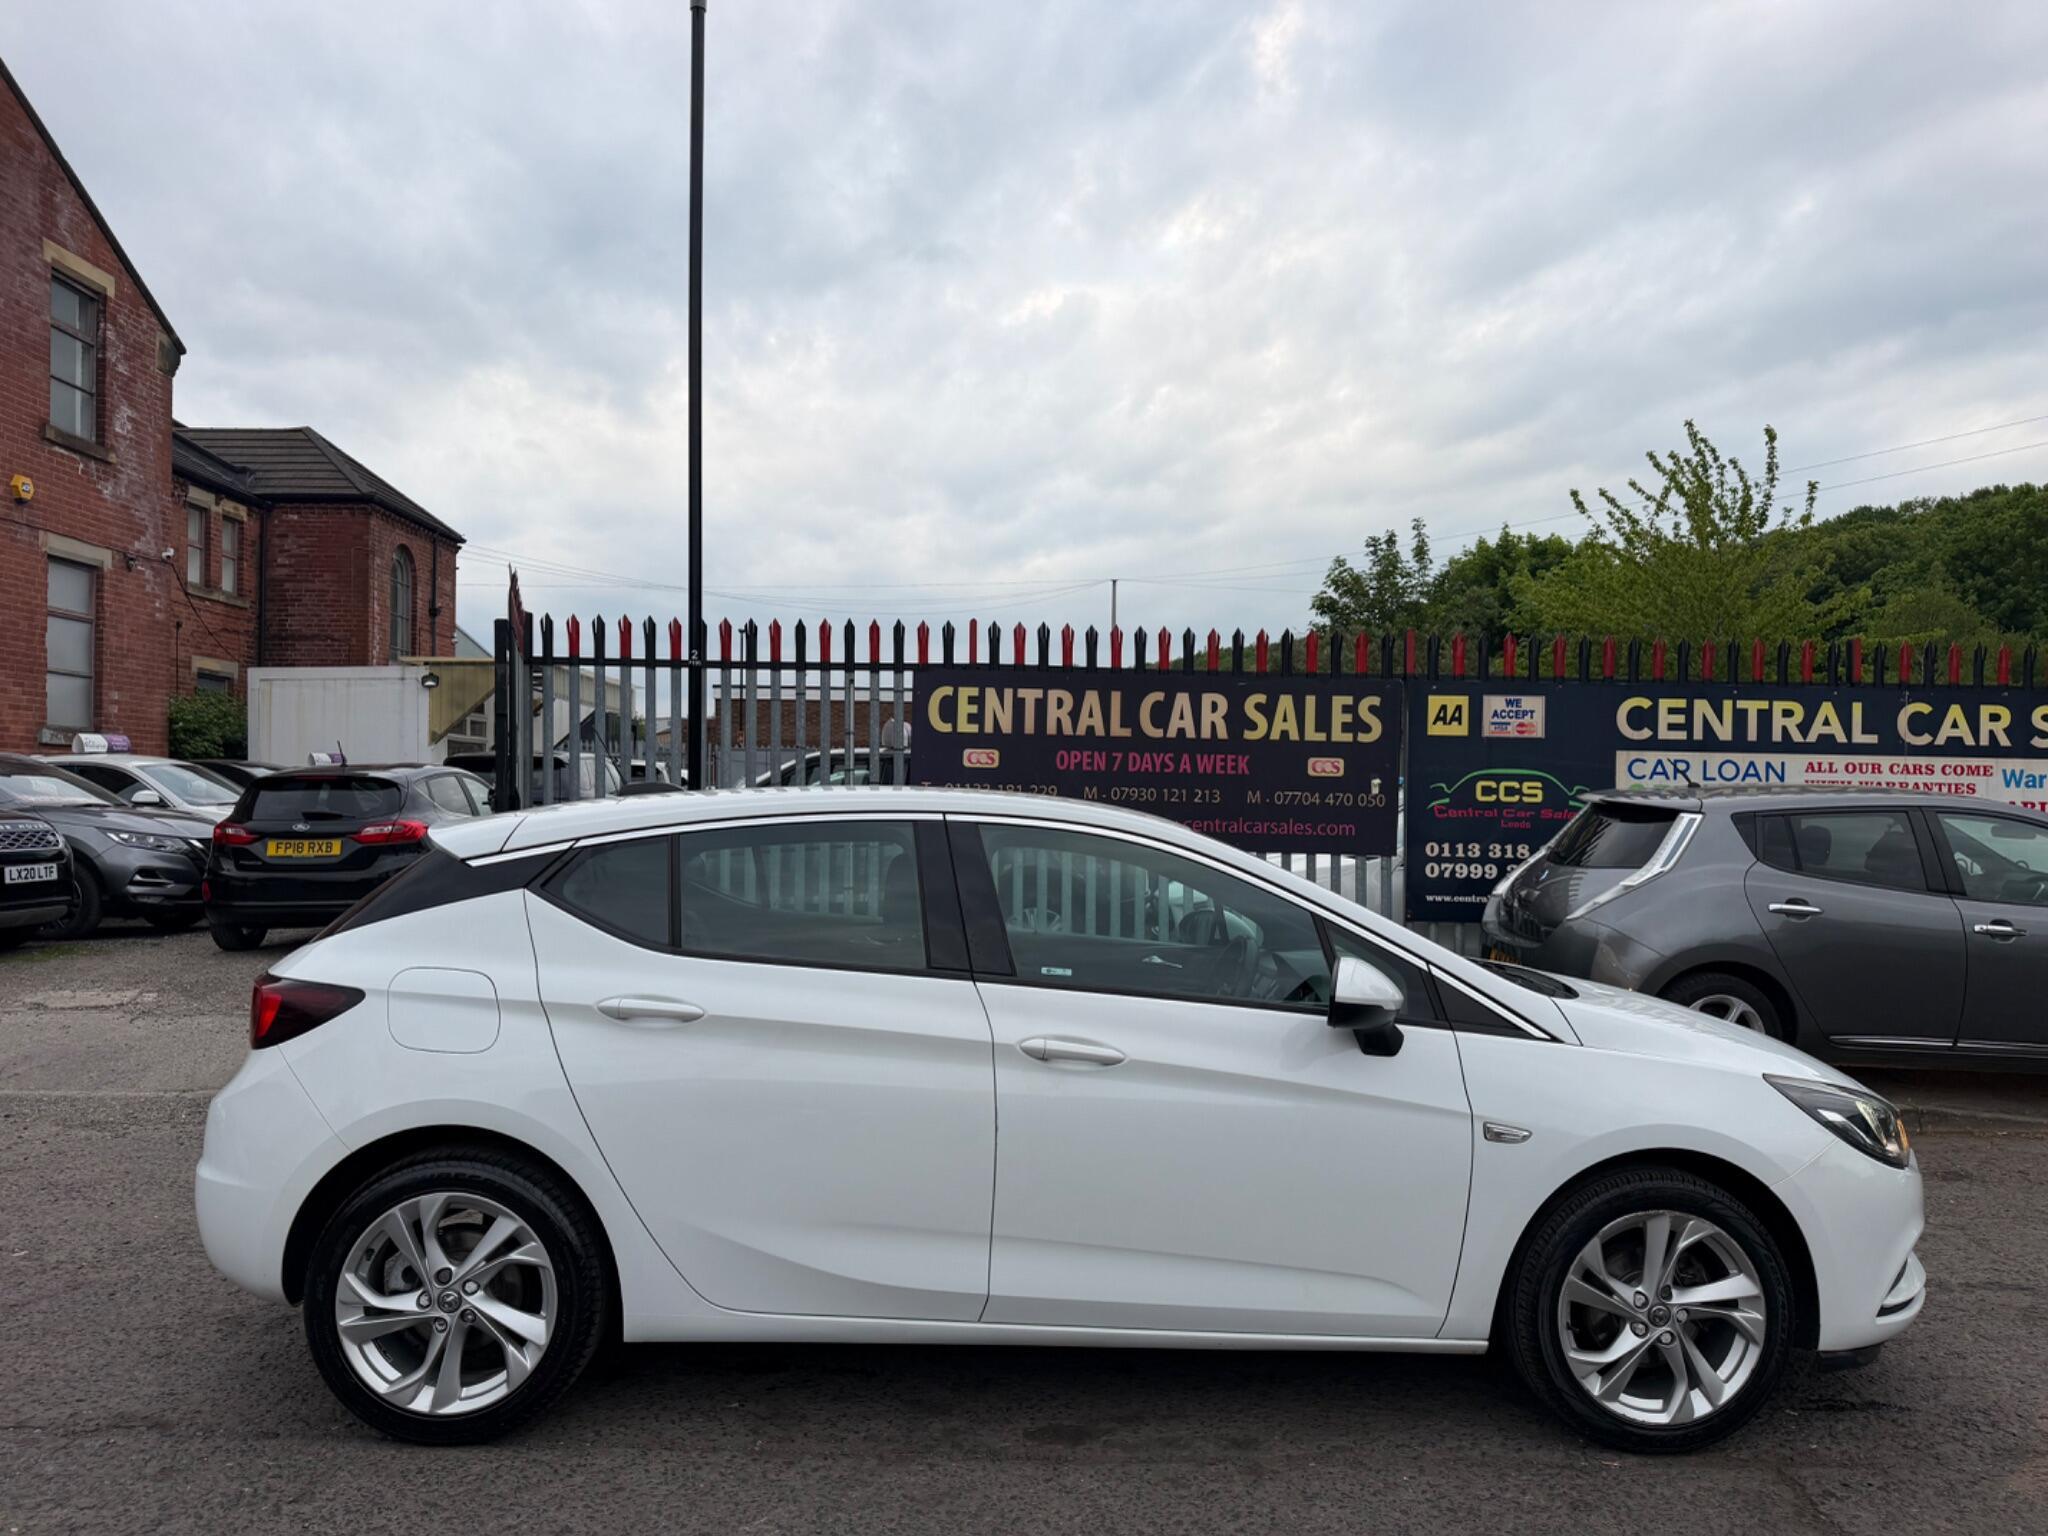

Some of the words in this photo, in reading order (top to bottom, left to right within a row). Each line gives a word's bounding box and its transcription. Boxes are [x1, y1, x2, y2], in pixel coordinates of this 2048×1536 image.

[1504, 698, 1522, 708] WE
[927, 685, 1132, 738] CENTRAL
[1139, 691, 1229, 740] CAR
[1243, 693, 1383, 743] SALES
[1432, 704, 1463, 726] AA
[1491, 709, 1536, 720] ACCEPT
[1615, 696, 1879, 744] CENTRAL
[1896, 702, 2012, 747] CAR
[1056, 750, 1106, 771] OPEN
[1112, 752, 1123, 772] 7
[1128, 752, 1175, 773] DAYS
[1179, 754, 1192, 773] A
[1197, 754, 1250, 775] WEEK
[1627, 757, 1691, 781] CAR
[1702, 759, 1785, 783] LOAN
[1804, 761, 1838, 774] ALL
[1844, 761, 1884, 775] OUR
[1888, 762, 1935, 776] CARS
[1941, 763, 1994, 777] COME
[2002, 767, 2047, 789] War
[1083, 786, 1098, 800] M
[1110, 787, 1157, 801] 07930
[1162, 788, 1187, 802] 121
[1194, 788, 1221, 804] 213
[1247, 790, 1261, 804] M
[1274, 791, 1321, 805] 07704
[1325, 792, 1353, 806] 470
[1357, 793, 1386, 807] 050
[1475, 780, 1543, 803] CCS
[1433, 804, 1498, 819] Central
[1503, 807, 1535, 819] Car
[1539, 807, 1580, 820] Sale
[1176, 816, 1356, 837] centralcarsales.com
[274, 841, 305, 854] FP18
[307, 841, 334, 854] RXB
[1425, 841, 1481, 858] 0113
[1488, 843, 1531, 859] 318
[9, 867, 35, 881] LX20
[37, 865, 55, 879] LTF
[1424, 861, 1499, 880] 07999
